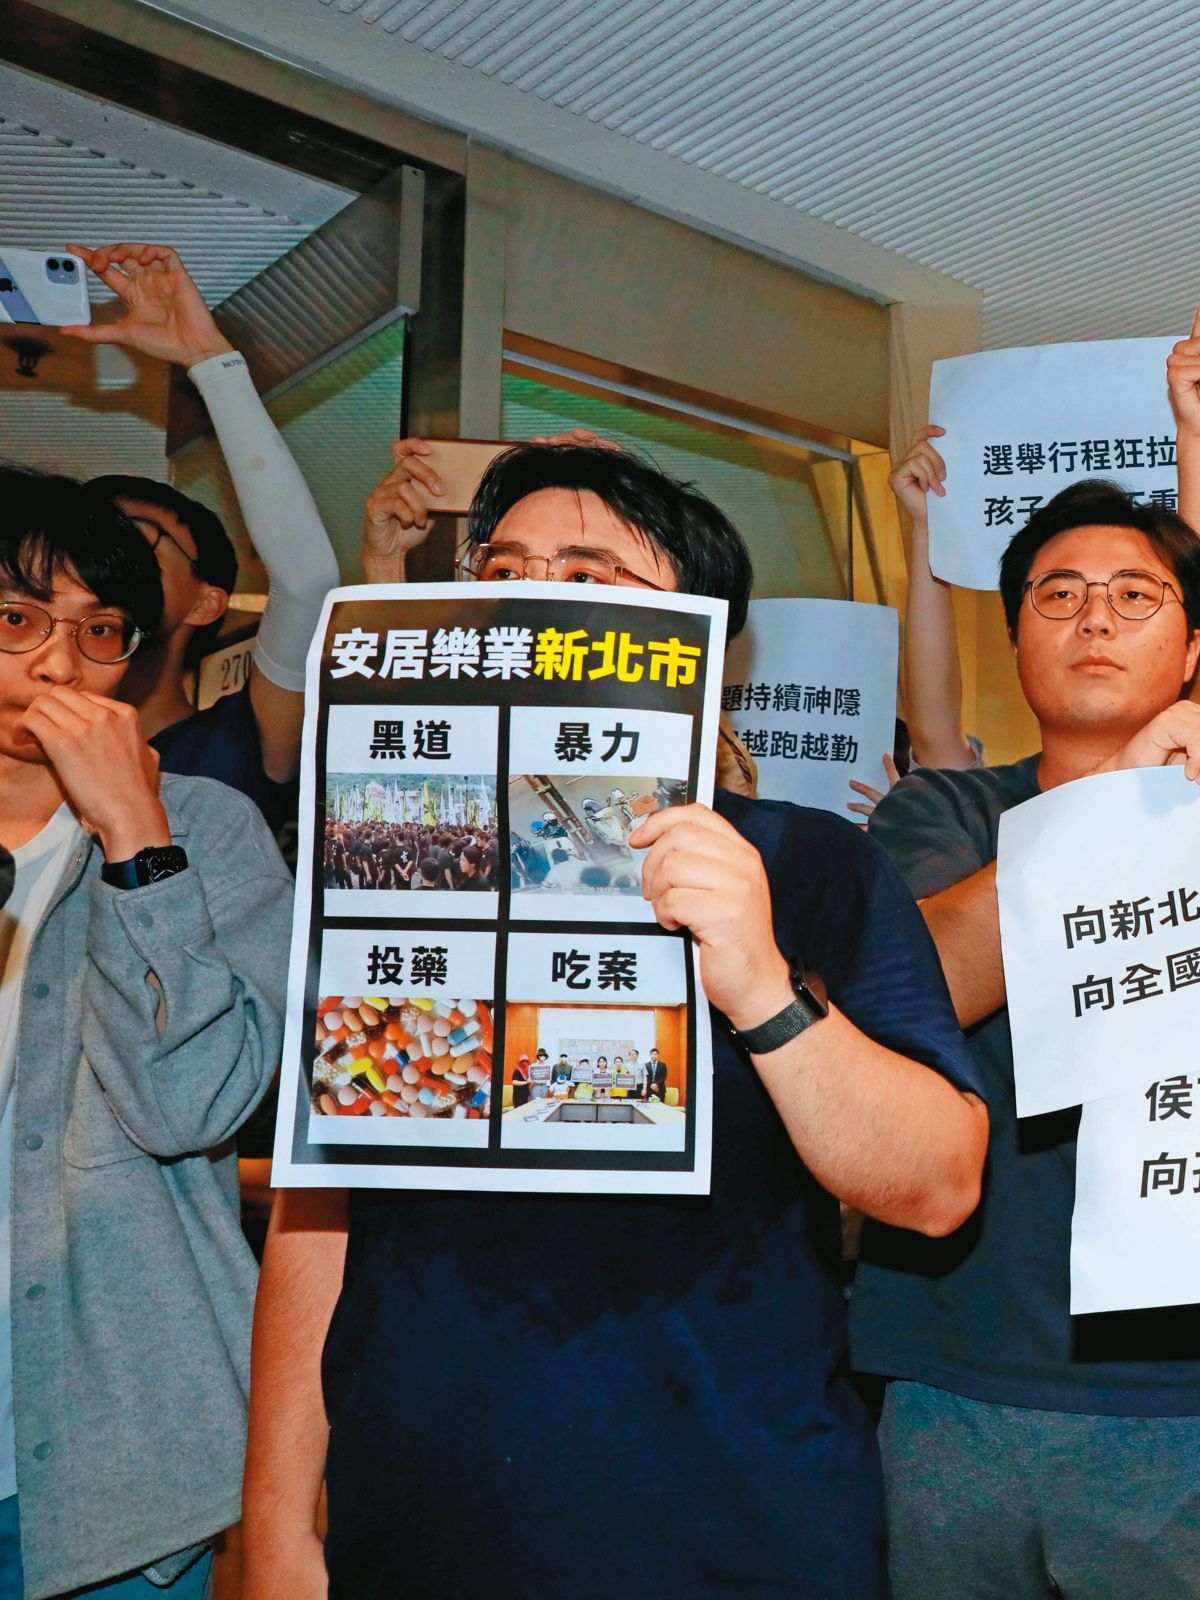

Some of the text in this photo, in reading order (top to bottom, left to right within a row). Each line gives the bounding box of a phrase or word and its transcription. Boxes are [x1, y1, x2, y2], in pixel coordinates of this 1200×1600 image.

[983, 436, 1177, 475] 選舉行程狂拉
[330, 627, 701, 688] 安居樂業新北市
[369, 720, 453, 762] 黑道
[554, 722, 640, 763] 暴力
[733, 729, 858, 764] 越跑越勤
[367, 946, 448, 987] 投藥
[551, 950, 638, 992] 吃案
